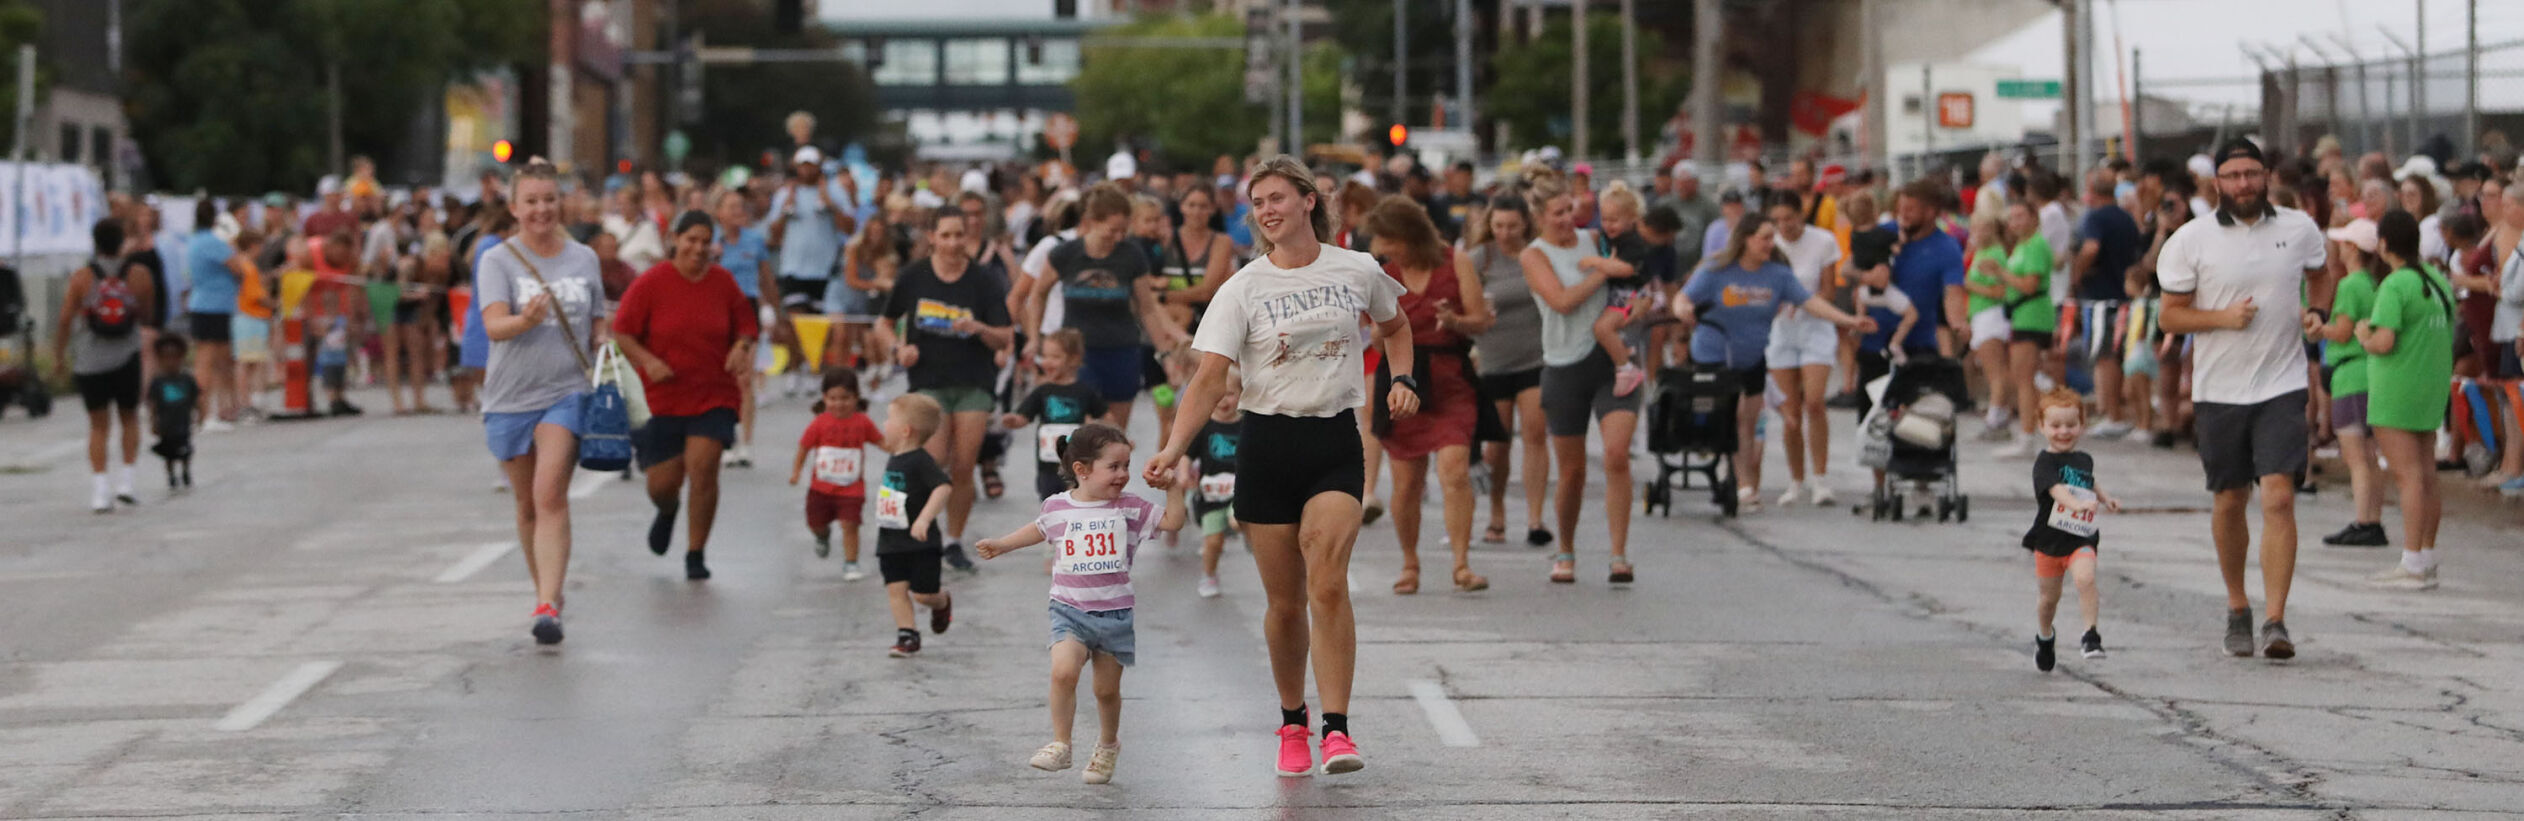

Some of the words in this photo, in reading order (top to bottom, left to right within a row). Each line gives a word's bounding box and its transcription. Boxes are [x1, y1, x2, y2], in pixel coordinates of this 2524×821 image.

[1089, 520, 1107, 530] BIX
[1109, 520, 1116, 529] 7
[1065, 540, 1075, 556] B
[1084, 533, 1117, 557] 331
[1072, 560, 1121, 572] ARCONIC
